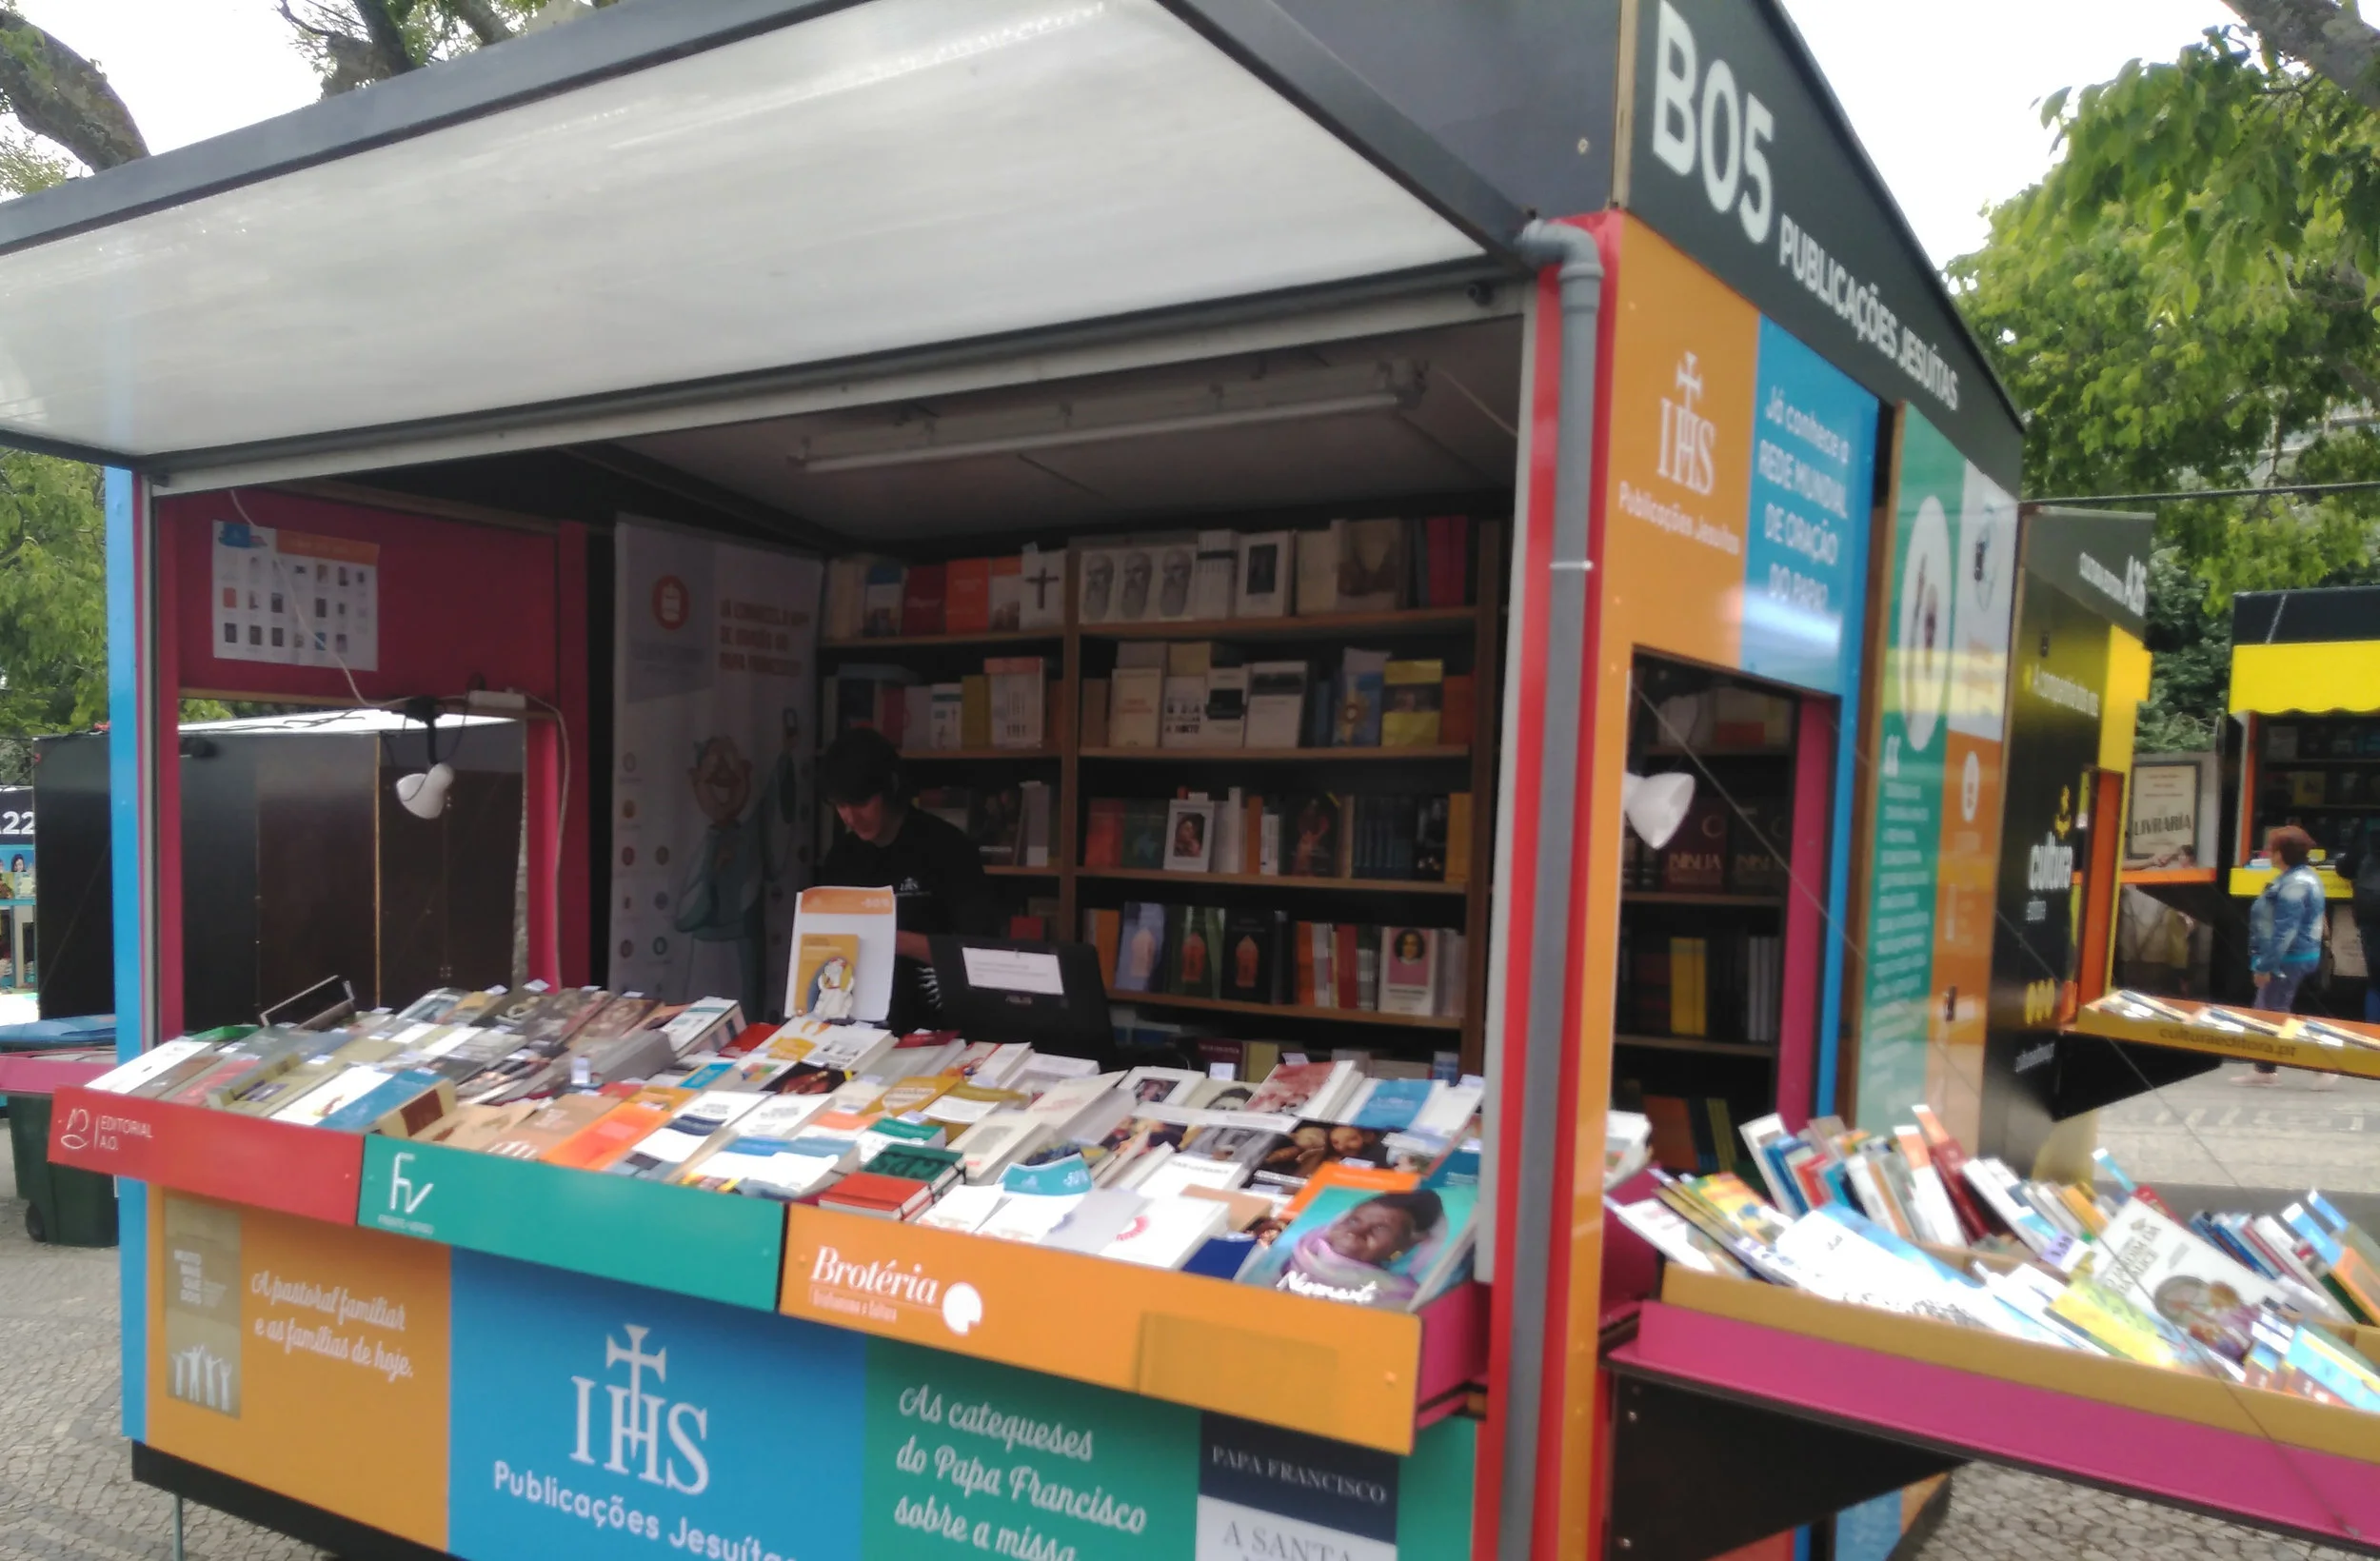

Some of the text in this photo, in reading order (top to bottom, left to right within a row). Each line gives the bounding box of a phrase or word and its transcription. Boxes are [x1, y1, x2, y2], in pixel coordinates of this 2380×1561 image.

[1653, 0, 1775, 245] B05
[1779, 214, 1958, 411] PUBLICAÇÕES JESUÍTAS
[1656, 397, 1716, 496] IHS
[0, 811, 35, 835] 22
[2134, 813, 2192, 836] LIVRARIA
[100, 1115, 154, 1139] EDITORIAL
[251, 1270, 271, 1296] A
[270, 1275, 340, 1314] pastoral
[338, 1288, 406, 1332] familiar
[810, 1245, 940, 1304] Brotéria
[254, 1317, 265, 1335] e
[266, 1320, 284, 1342] as
[351, 1335, 371, 1365] de
[568, 1375, 710, 1496] IHS
[899, 1384, 1094, 1462] As catequeses
[896, 1434, 1147, 1535] do Papa Francisco
[1212, 1445, 1387, 1506] PAPA FRANCISCO
[493, 1460, 797, 1561] Publicações Jesuít
[894, 1494, 968, 1543] sobre
[972, 1521, 992, 1551] a
[1222, 1521, 1242, 1548] A
